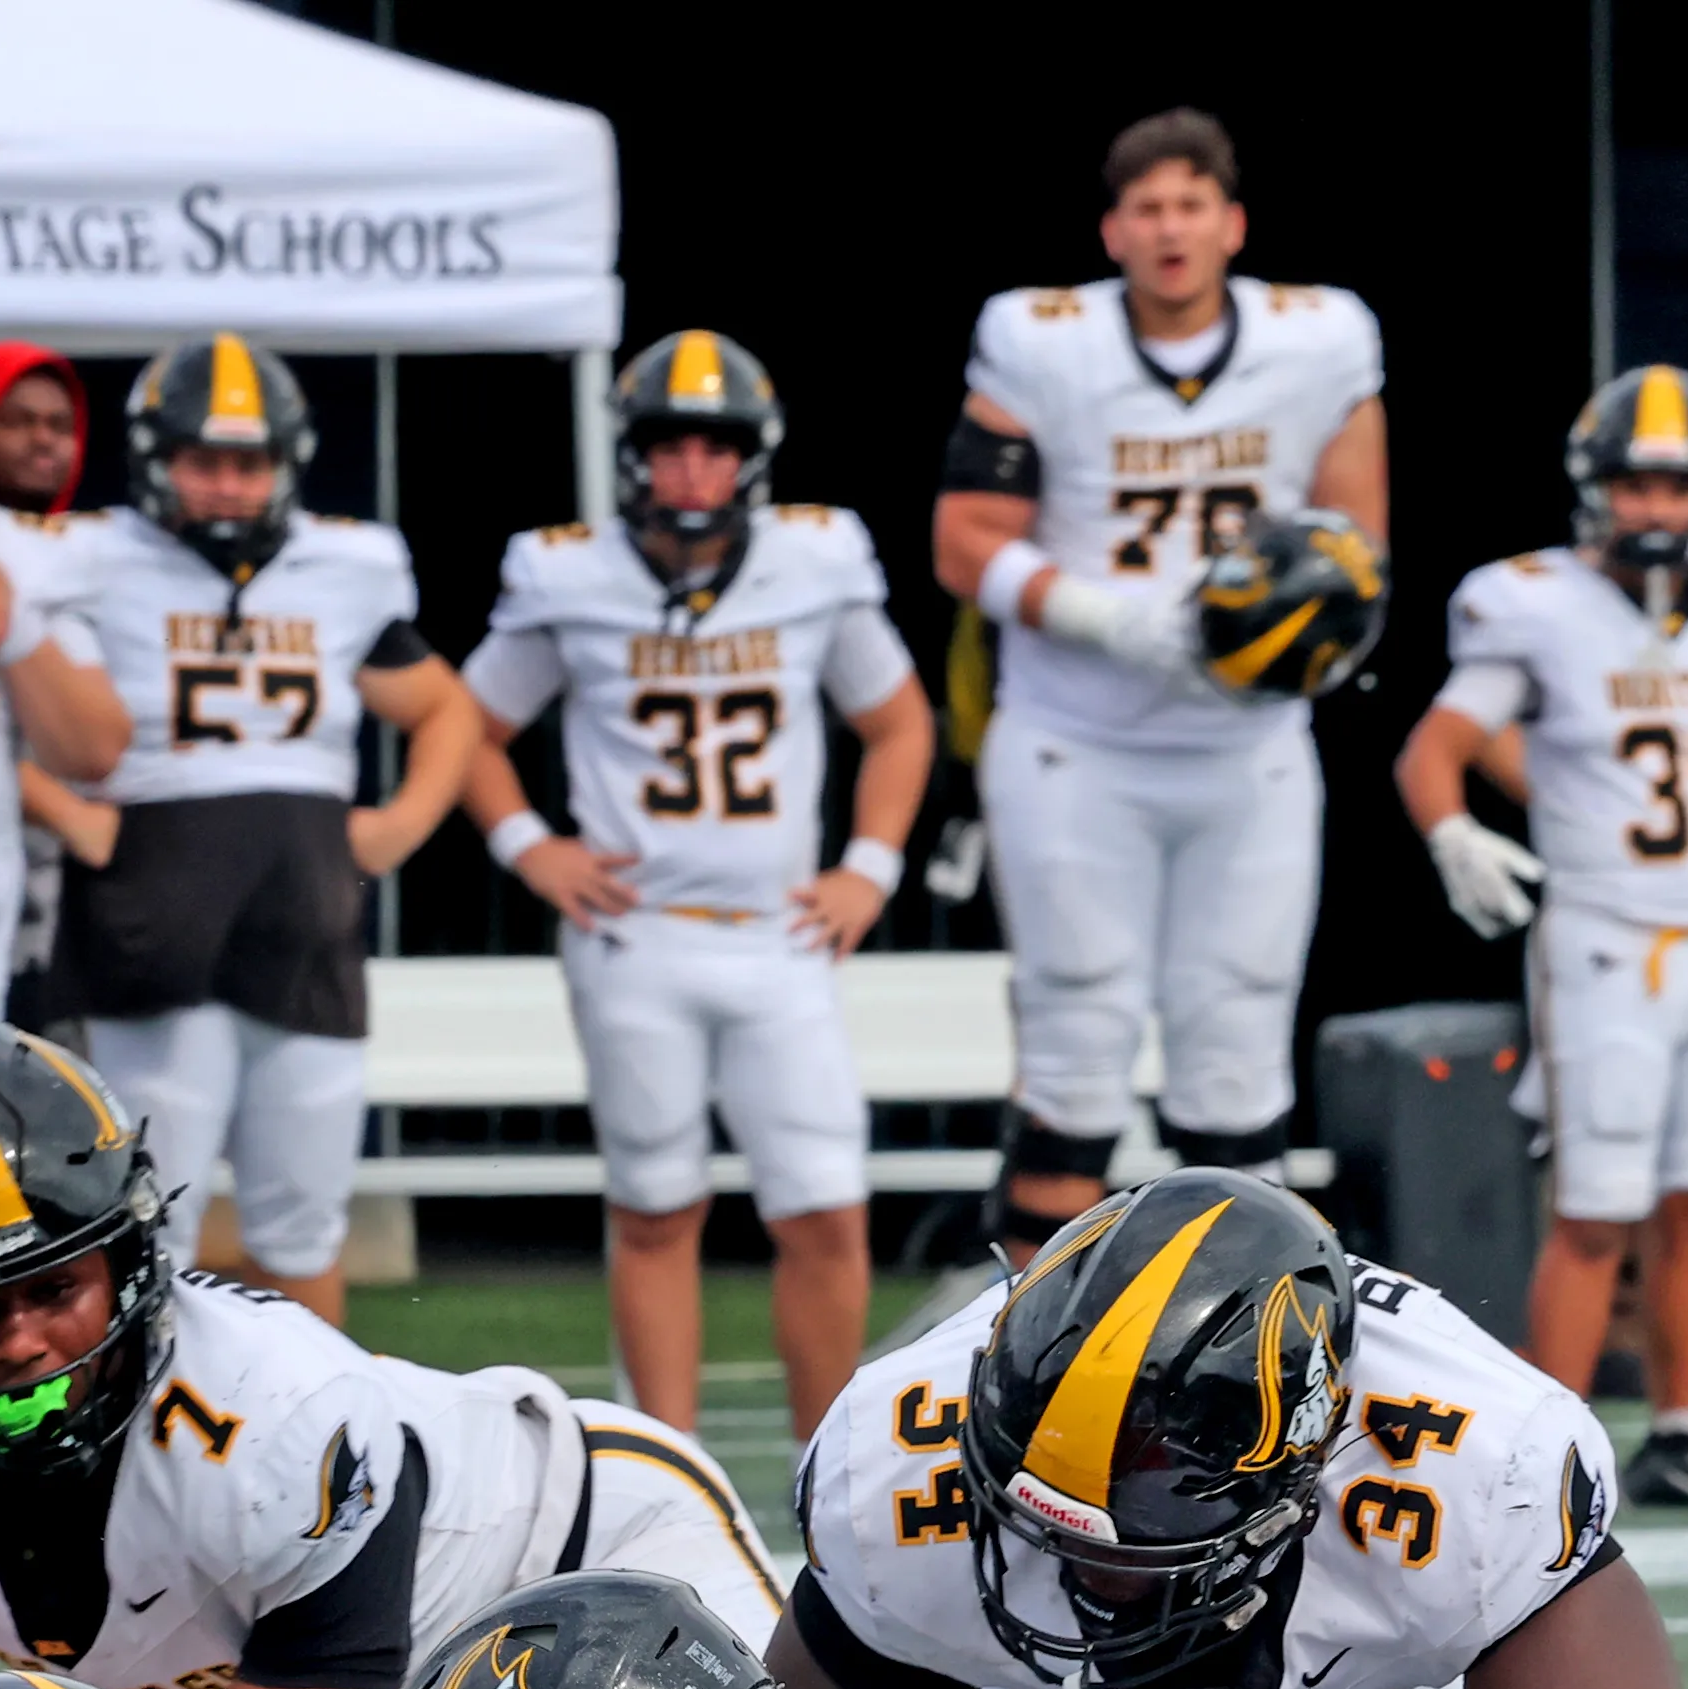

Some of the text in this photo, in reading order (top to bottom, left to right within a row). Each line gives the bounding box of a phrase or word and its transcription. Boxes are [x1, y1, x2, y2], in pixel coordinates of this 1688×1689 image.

[177, 182, 505, 279] SCHOOLS
[628, 685, 782, 822] 32
[153, 1378, 245, 1464] 7
[1338, 1392, 1477, 1571] 34
